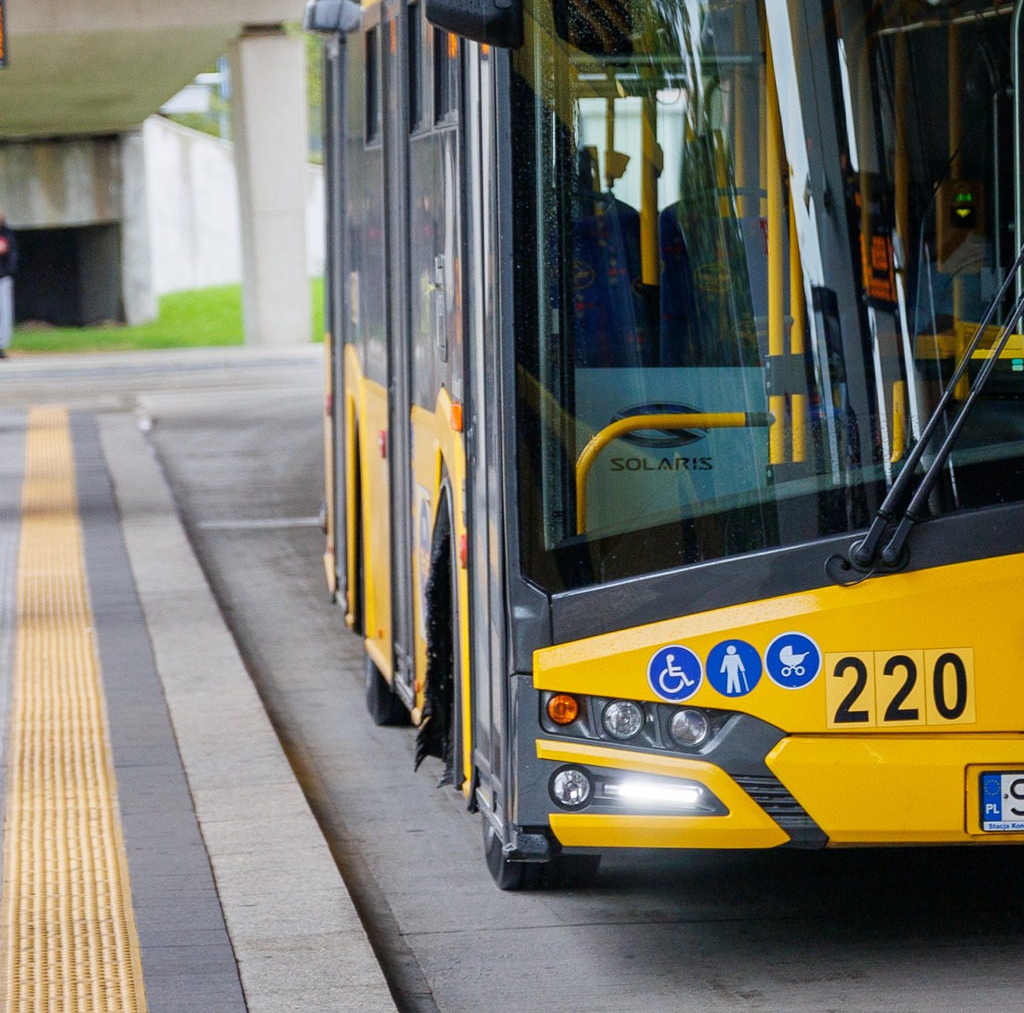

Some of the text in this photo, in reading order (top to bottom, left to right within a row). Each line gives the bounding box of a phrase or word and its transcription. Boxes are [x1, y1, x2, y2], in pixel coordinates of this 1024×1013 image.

[610, 457, 713, 472] SOLARIS
[833, 652, 968, 724] 220
[985, 804, 1000, 814] PL
